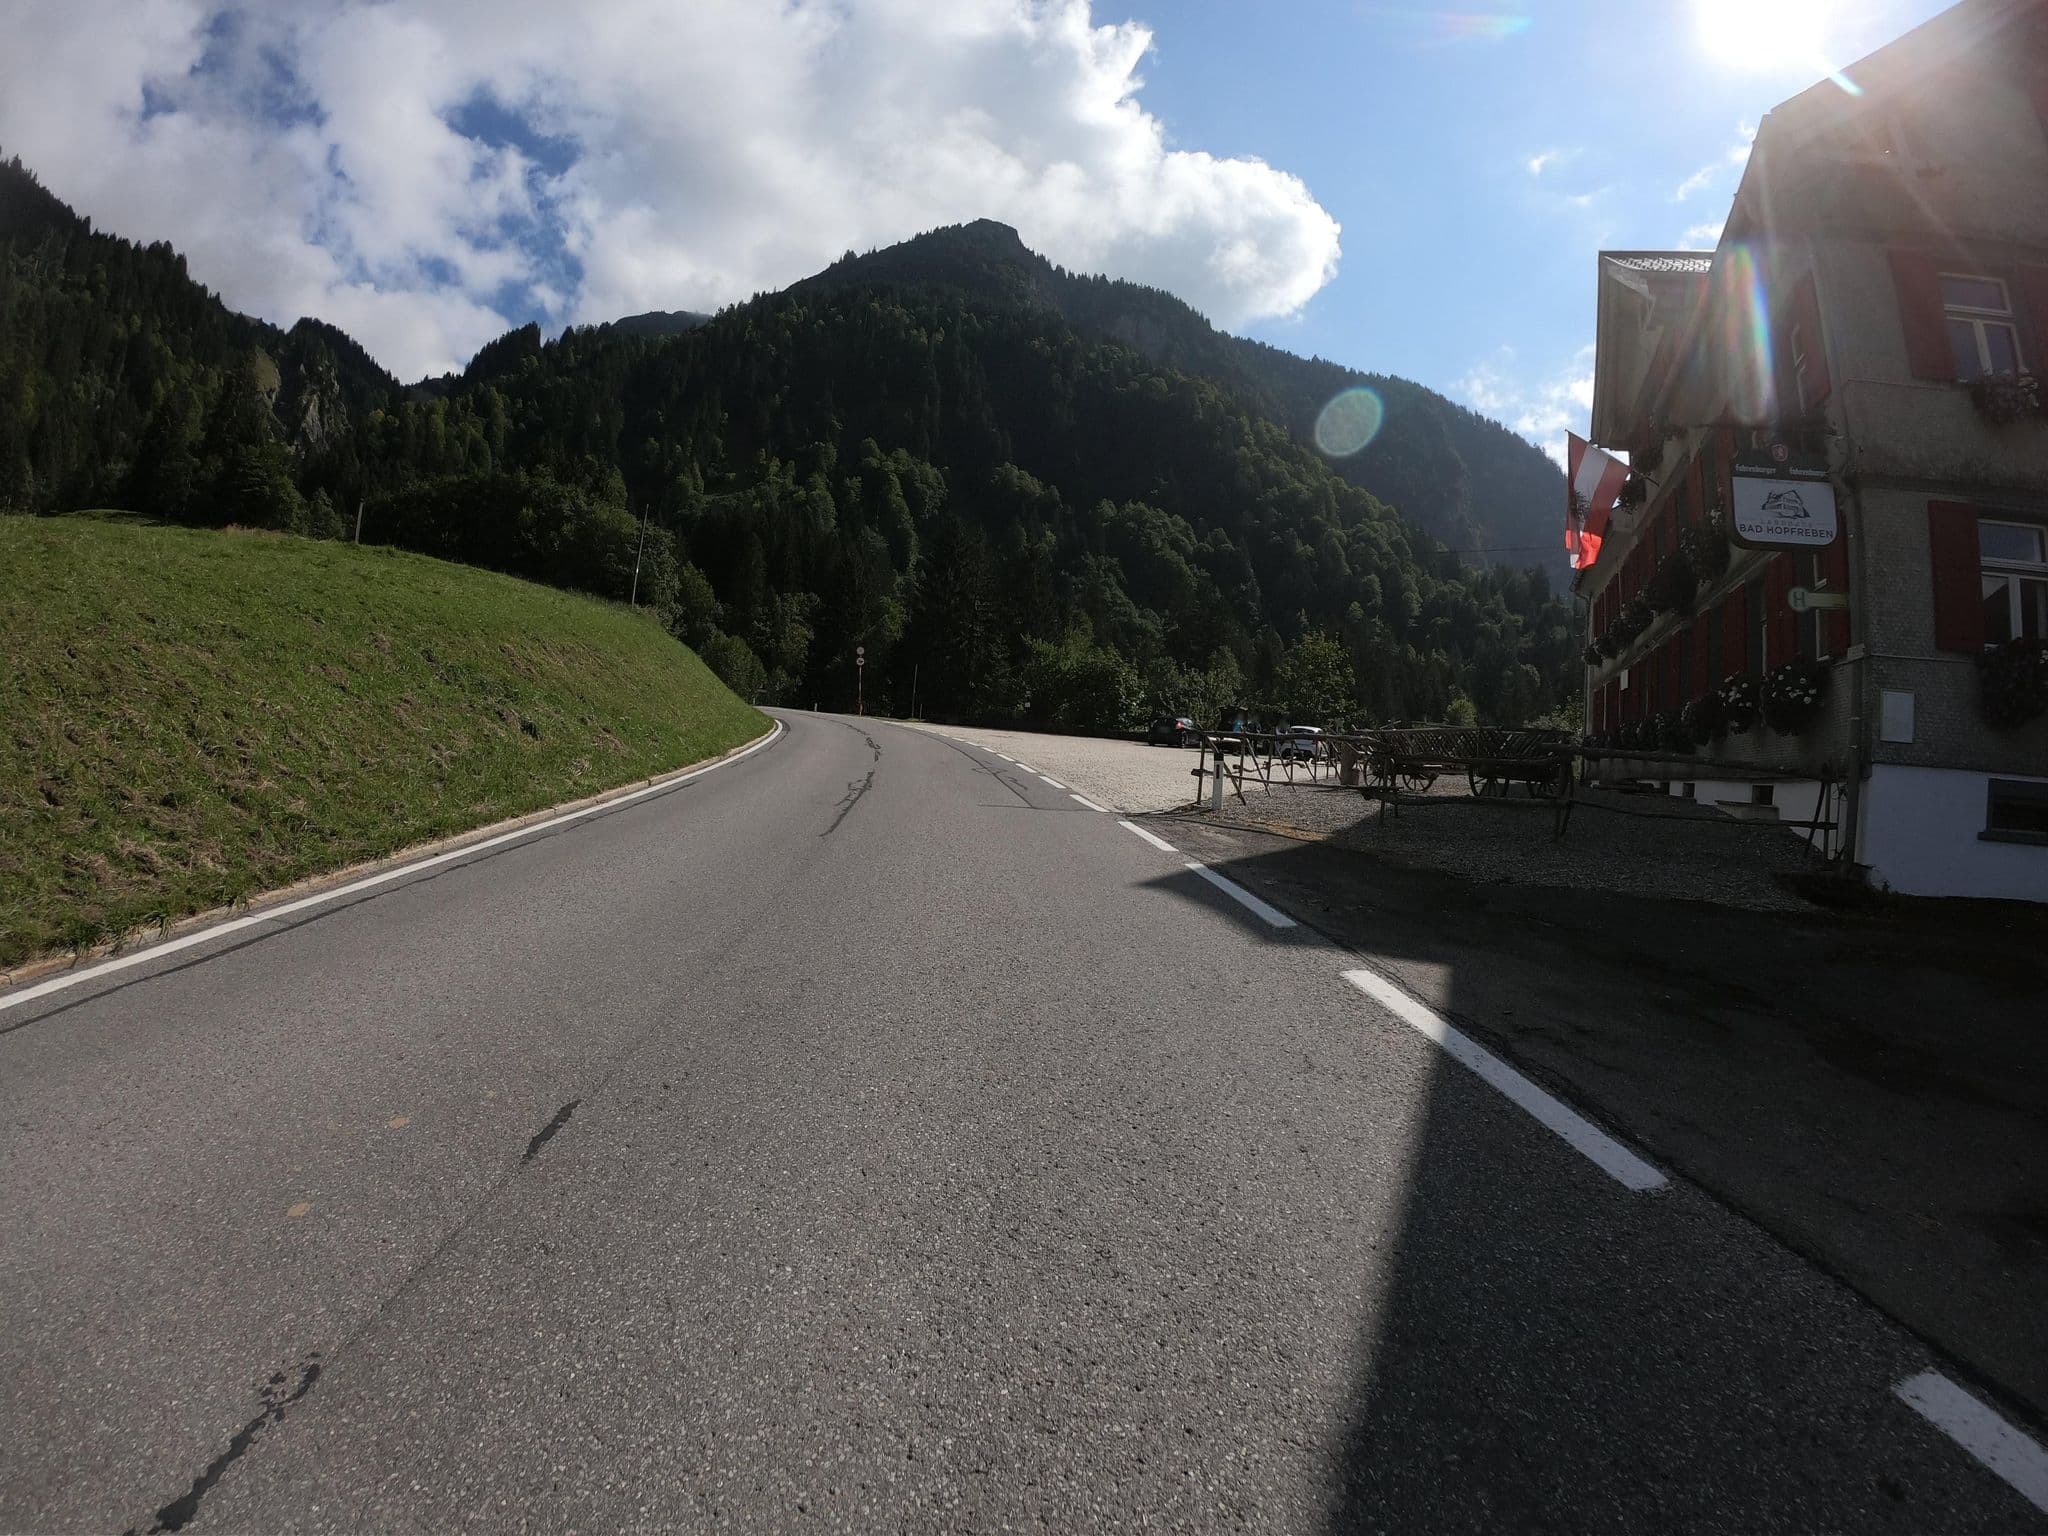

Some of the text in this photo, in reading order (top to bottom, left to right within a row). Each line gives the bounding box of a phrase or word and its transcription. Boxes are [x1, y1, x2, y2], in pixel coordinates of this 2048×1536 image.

[1739, 523, 1763, 533] BAD
[1767, 526, 1833, 538] HOPFREBEN
[1793, 591, 1805, 607] H
